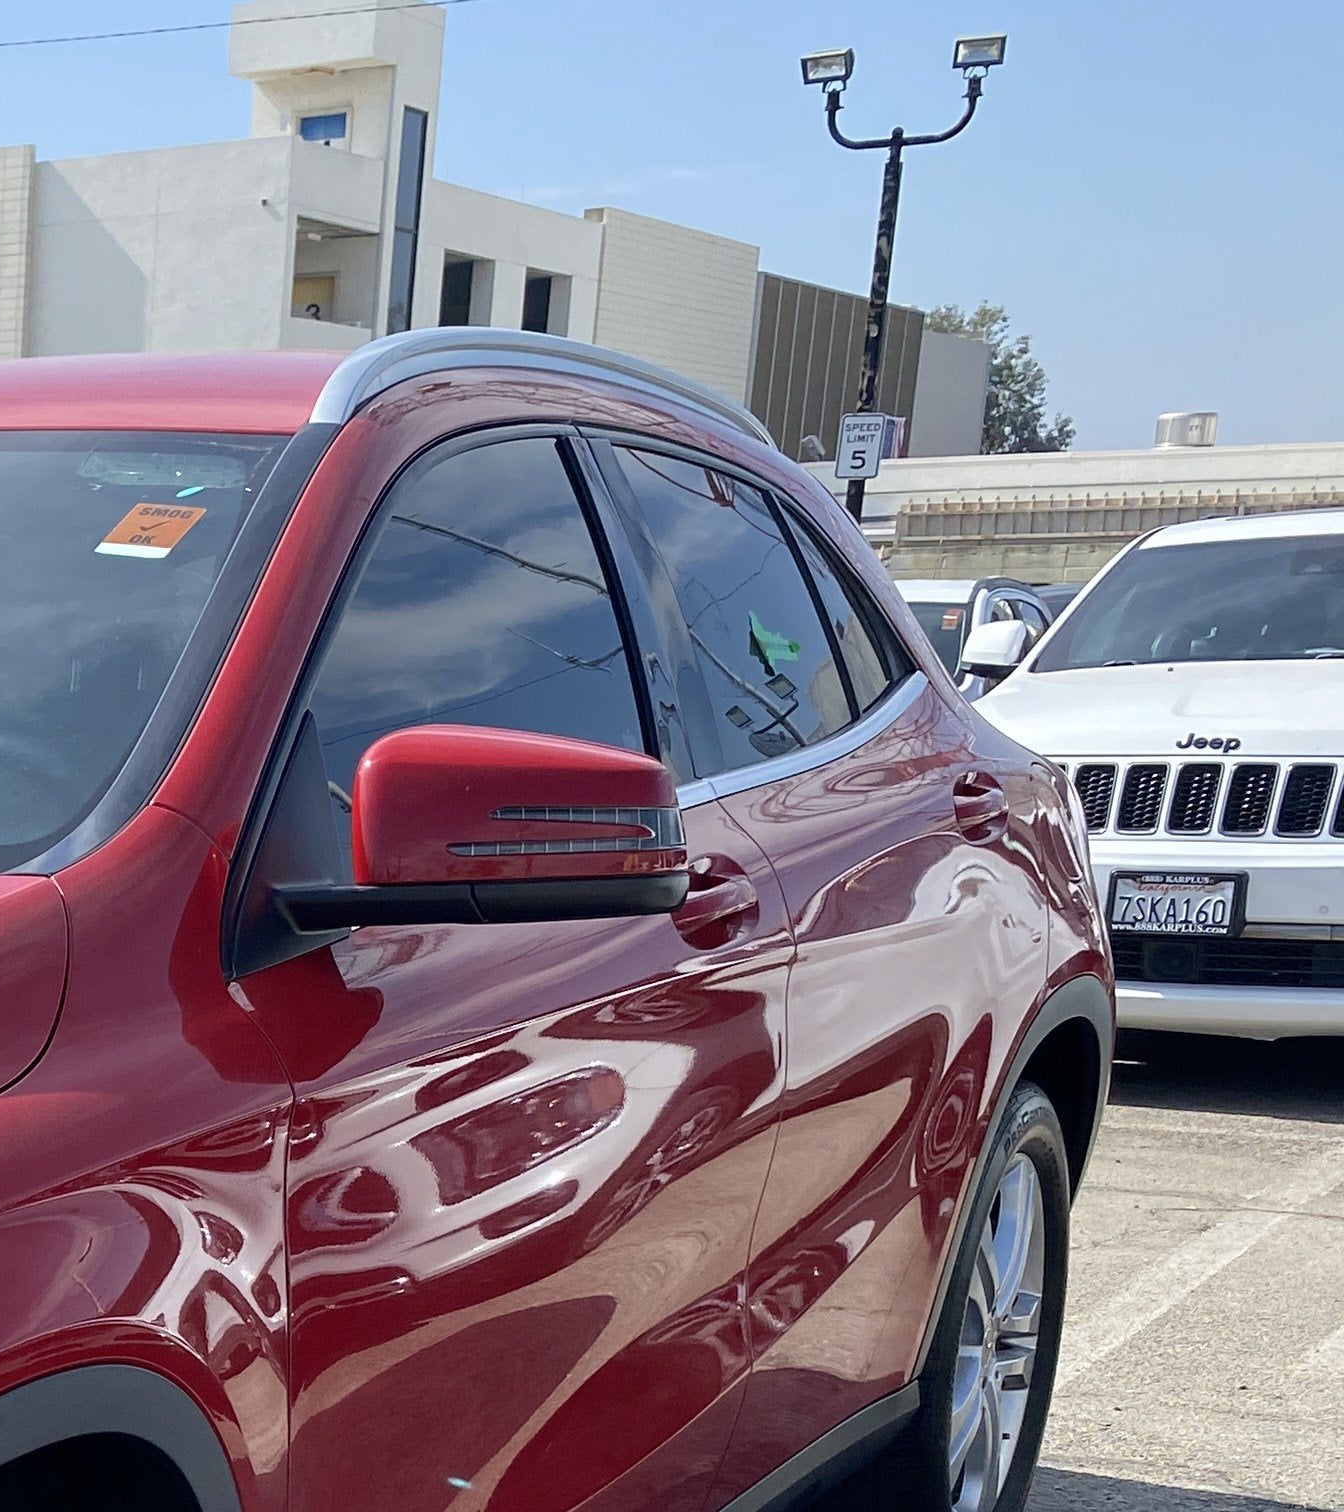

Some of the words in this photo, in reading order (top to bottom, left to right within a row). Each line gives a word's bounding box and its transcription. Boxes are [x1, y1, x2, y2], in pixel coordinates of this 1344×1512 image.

[845, 423, 881, 432] SPEED
[847, 434, 876, 443] LIMIT
[850, 450, 866, 469] 5
[139, 507, 194, 520] SMOG
[129, 534, 156, 545] OK
[1175, 733, 1241, 753] Jeep
[1165, 875, 1210, 884] KARPLUS
[1119, 896, 1226, 924] 7SKA160
